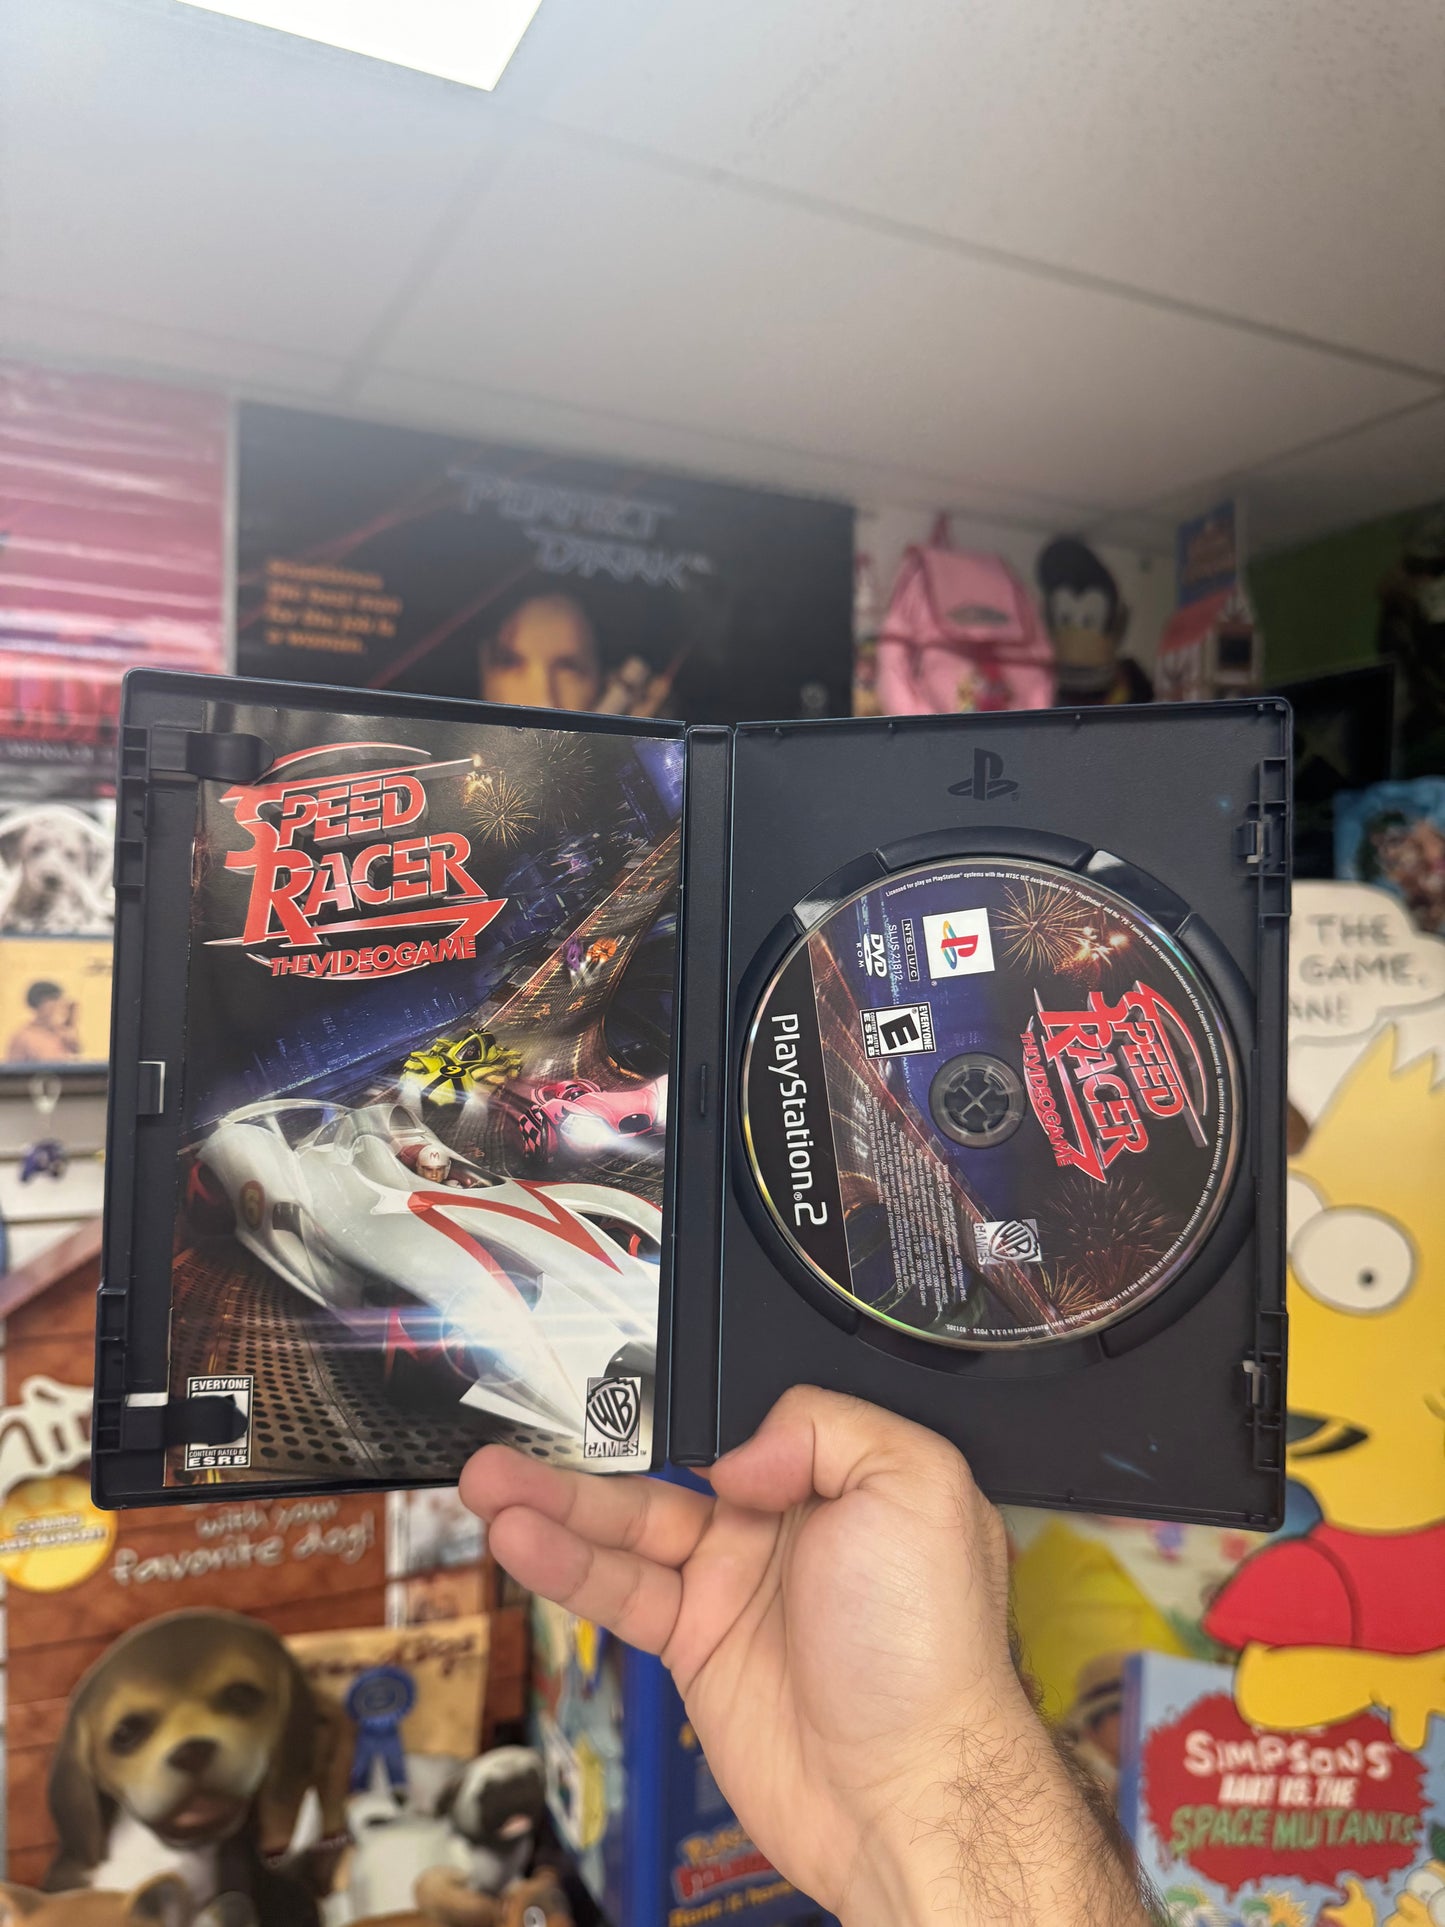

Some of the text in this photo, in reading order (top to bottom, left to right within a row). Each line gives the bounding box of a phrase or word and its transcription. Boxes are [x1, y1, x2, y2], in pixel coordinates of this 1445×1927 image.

[217, 772, 428, 870] SPEED
[240, 832, 490, 947] RACER
[904, 923, 914, 951] NTSC
[1307, 912, 1392, 946] THE
[856, 942, 865, 968] ROM
[870, 933, 888, 978] DVD
[889, 924, 903, 980] SLUS 21812
[863, 1012, 875, 1057] ESRB
[879, 1013, 920, 1051] E
[919, 1005, 933, 1051] EVERYONE
[1089, 980, 1190, 1120] SPEED
[1039, 1010, 1149, 1169] RACER
[973, 1223, 988, 1266] GAMES
[191, 1379, 250, 1391] EVERYONE
[591, 1386, 633, 1434] WB
[188, 1456, 247, 1467] ESRB
[189, 1449, 216, 1457] CONTENT
[585, 1441, 638, 1456] GAMES
[111, 1534, 286, 1586] favorite
[1184, 1730, 1393, 1780] SIMPSONS
[1170, 1804, 1422, 1856] SPACE MUTANTS
